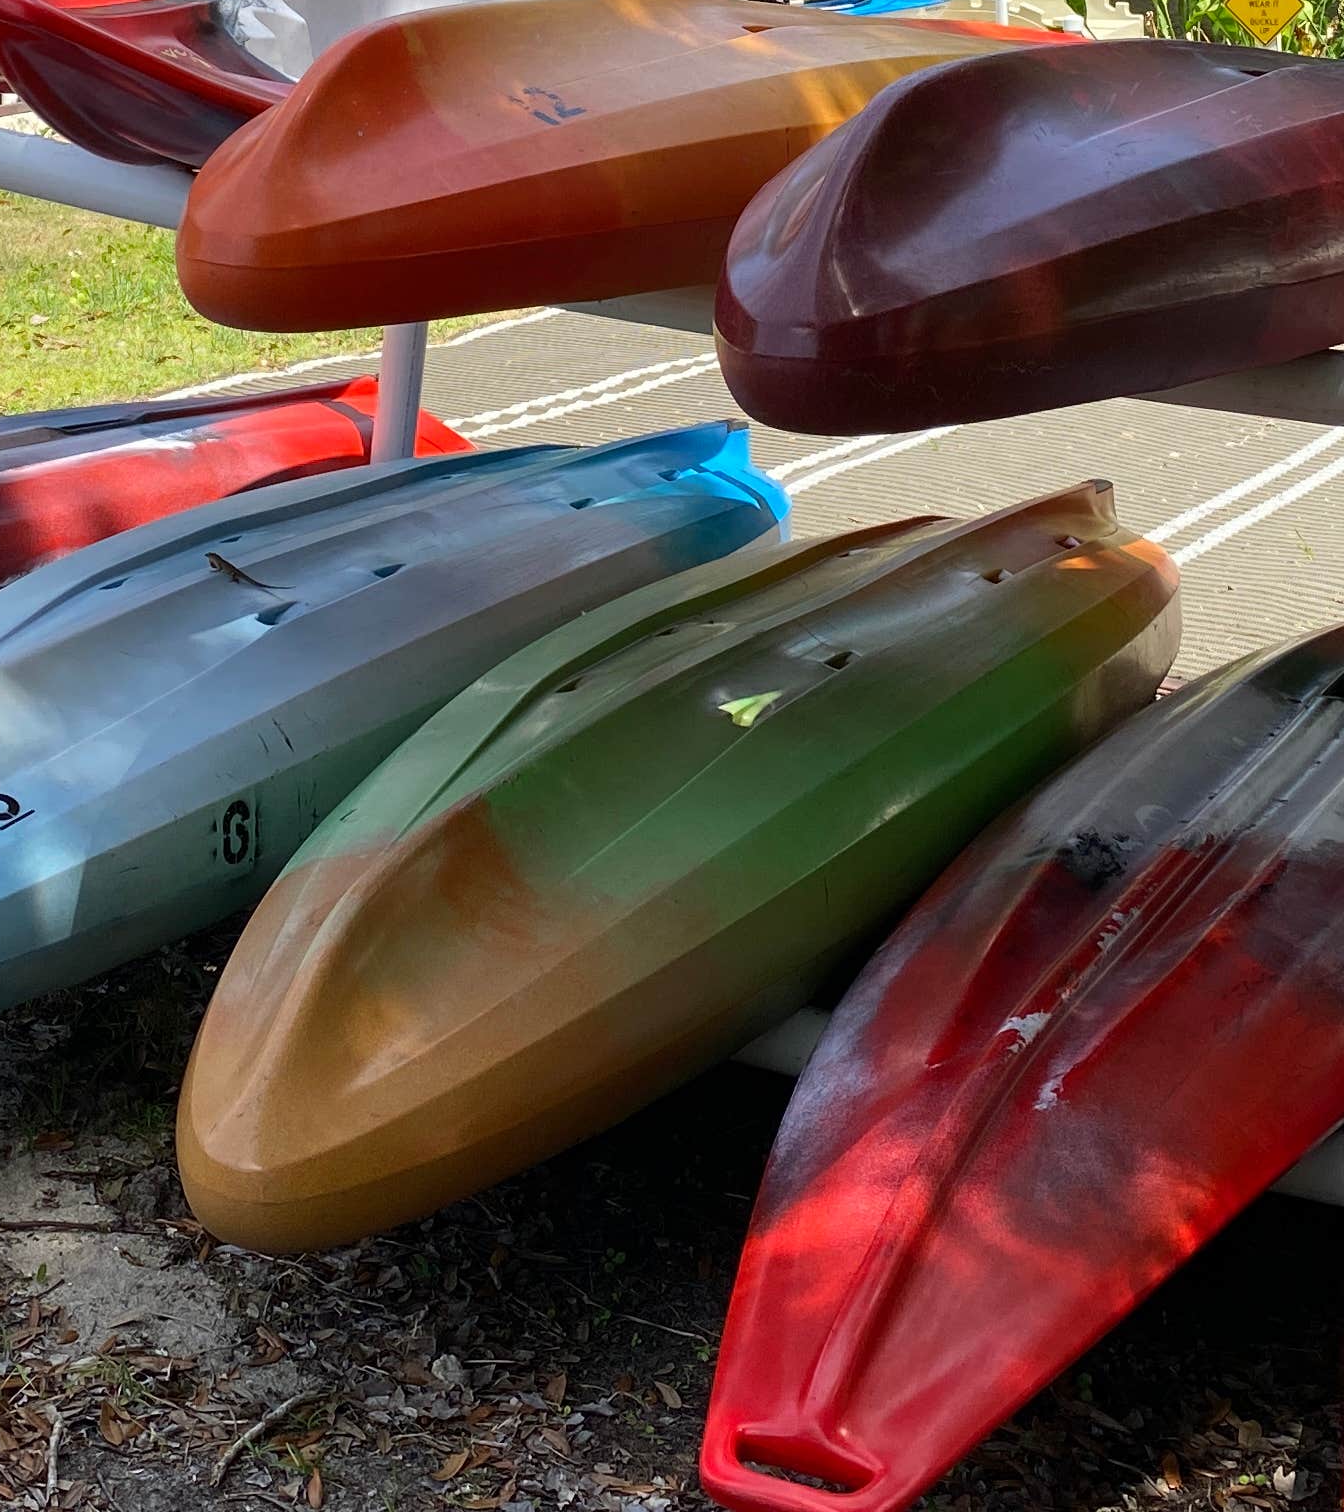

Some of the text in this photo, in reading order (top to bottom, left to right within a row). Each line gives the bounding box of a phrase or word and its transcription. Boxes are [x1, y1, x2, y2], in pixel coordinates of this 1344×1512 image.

[1248, 0, 1280, 8] WEAR IT
[1249, 18, 1279, 26] BUCKLE
[222, 800, 251, 865] 6
